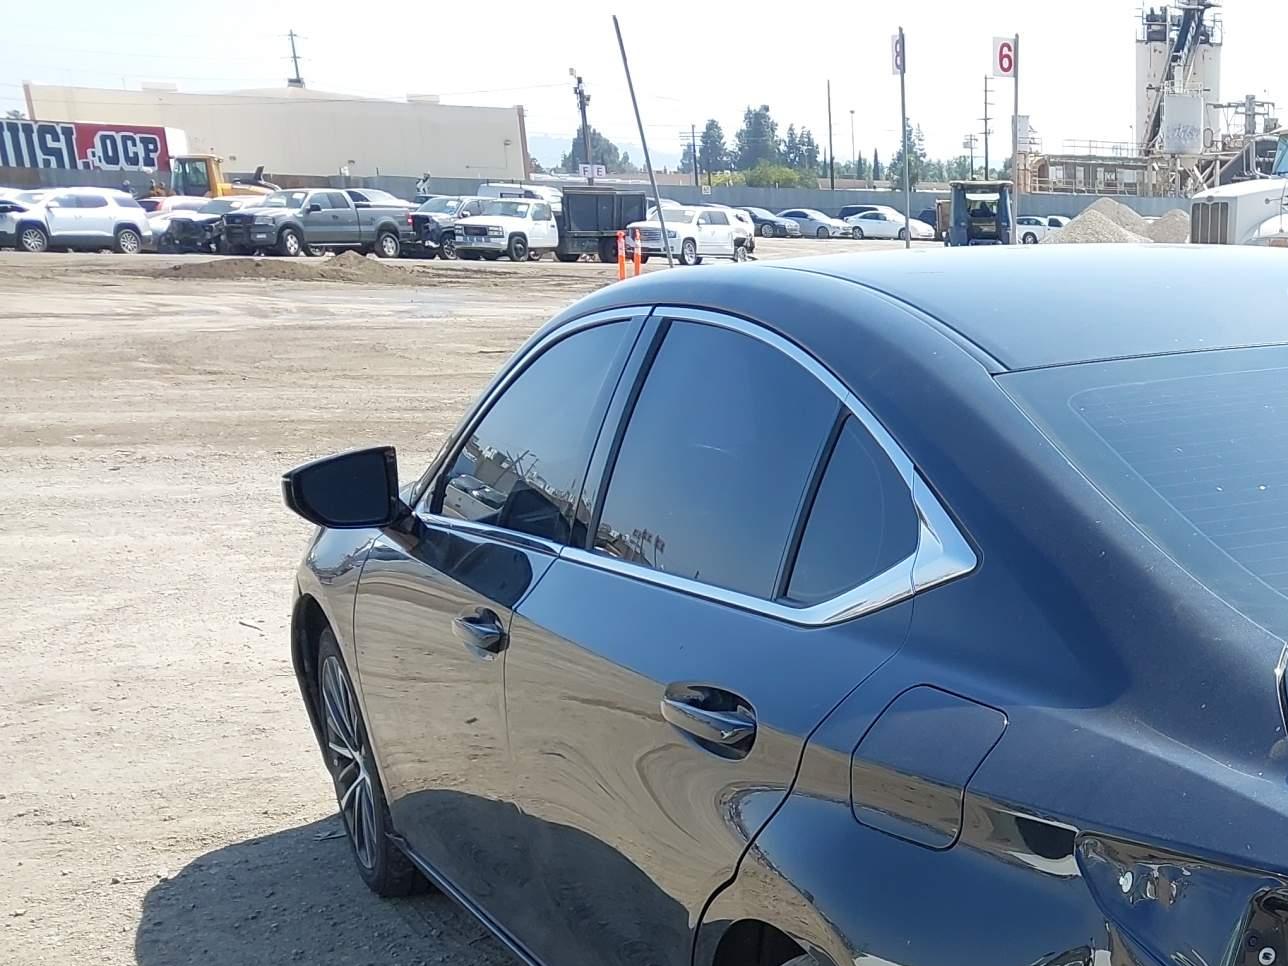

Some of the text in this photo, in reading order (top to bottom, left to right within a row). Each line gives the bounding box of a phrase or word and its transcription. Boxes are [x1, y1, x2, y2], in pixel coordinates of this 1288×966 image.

[998, 42, 1013, 72] 6
[582, 166, 603, 176] F E
